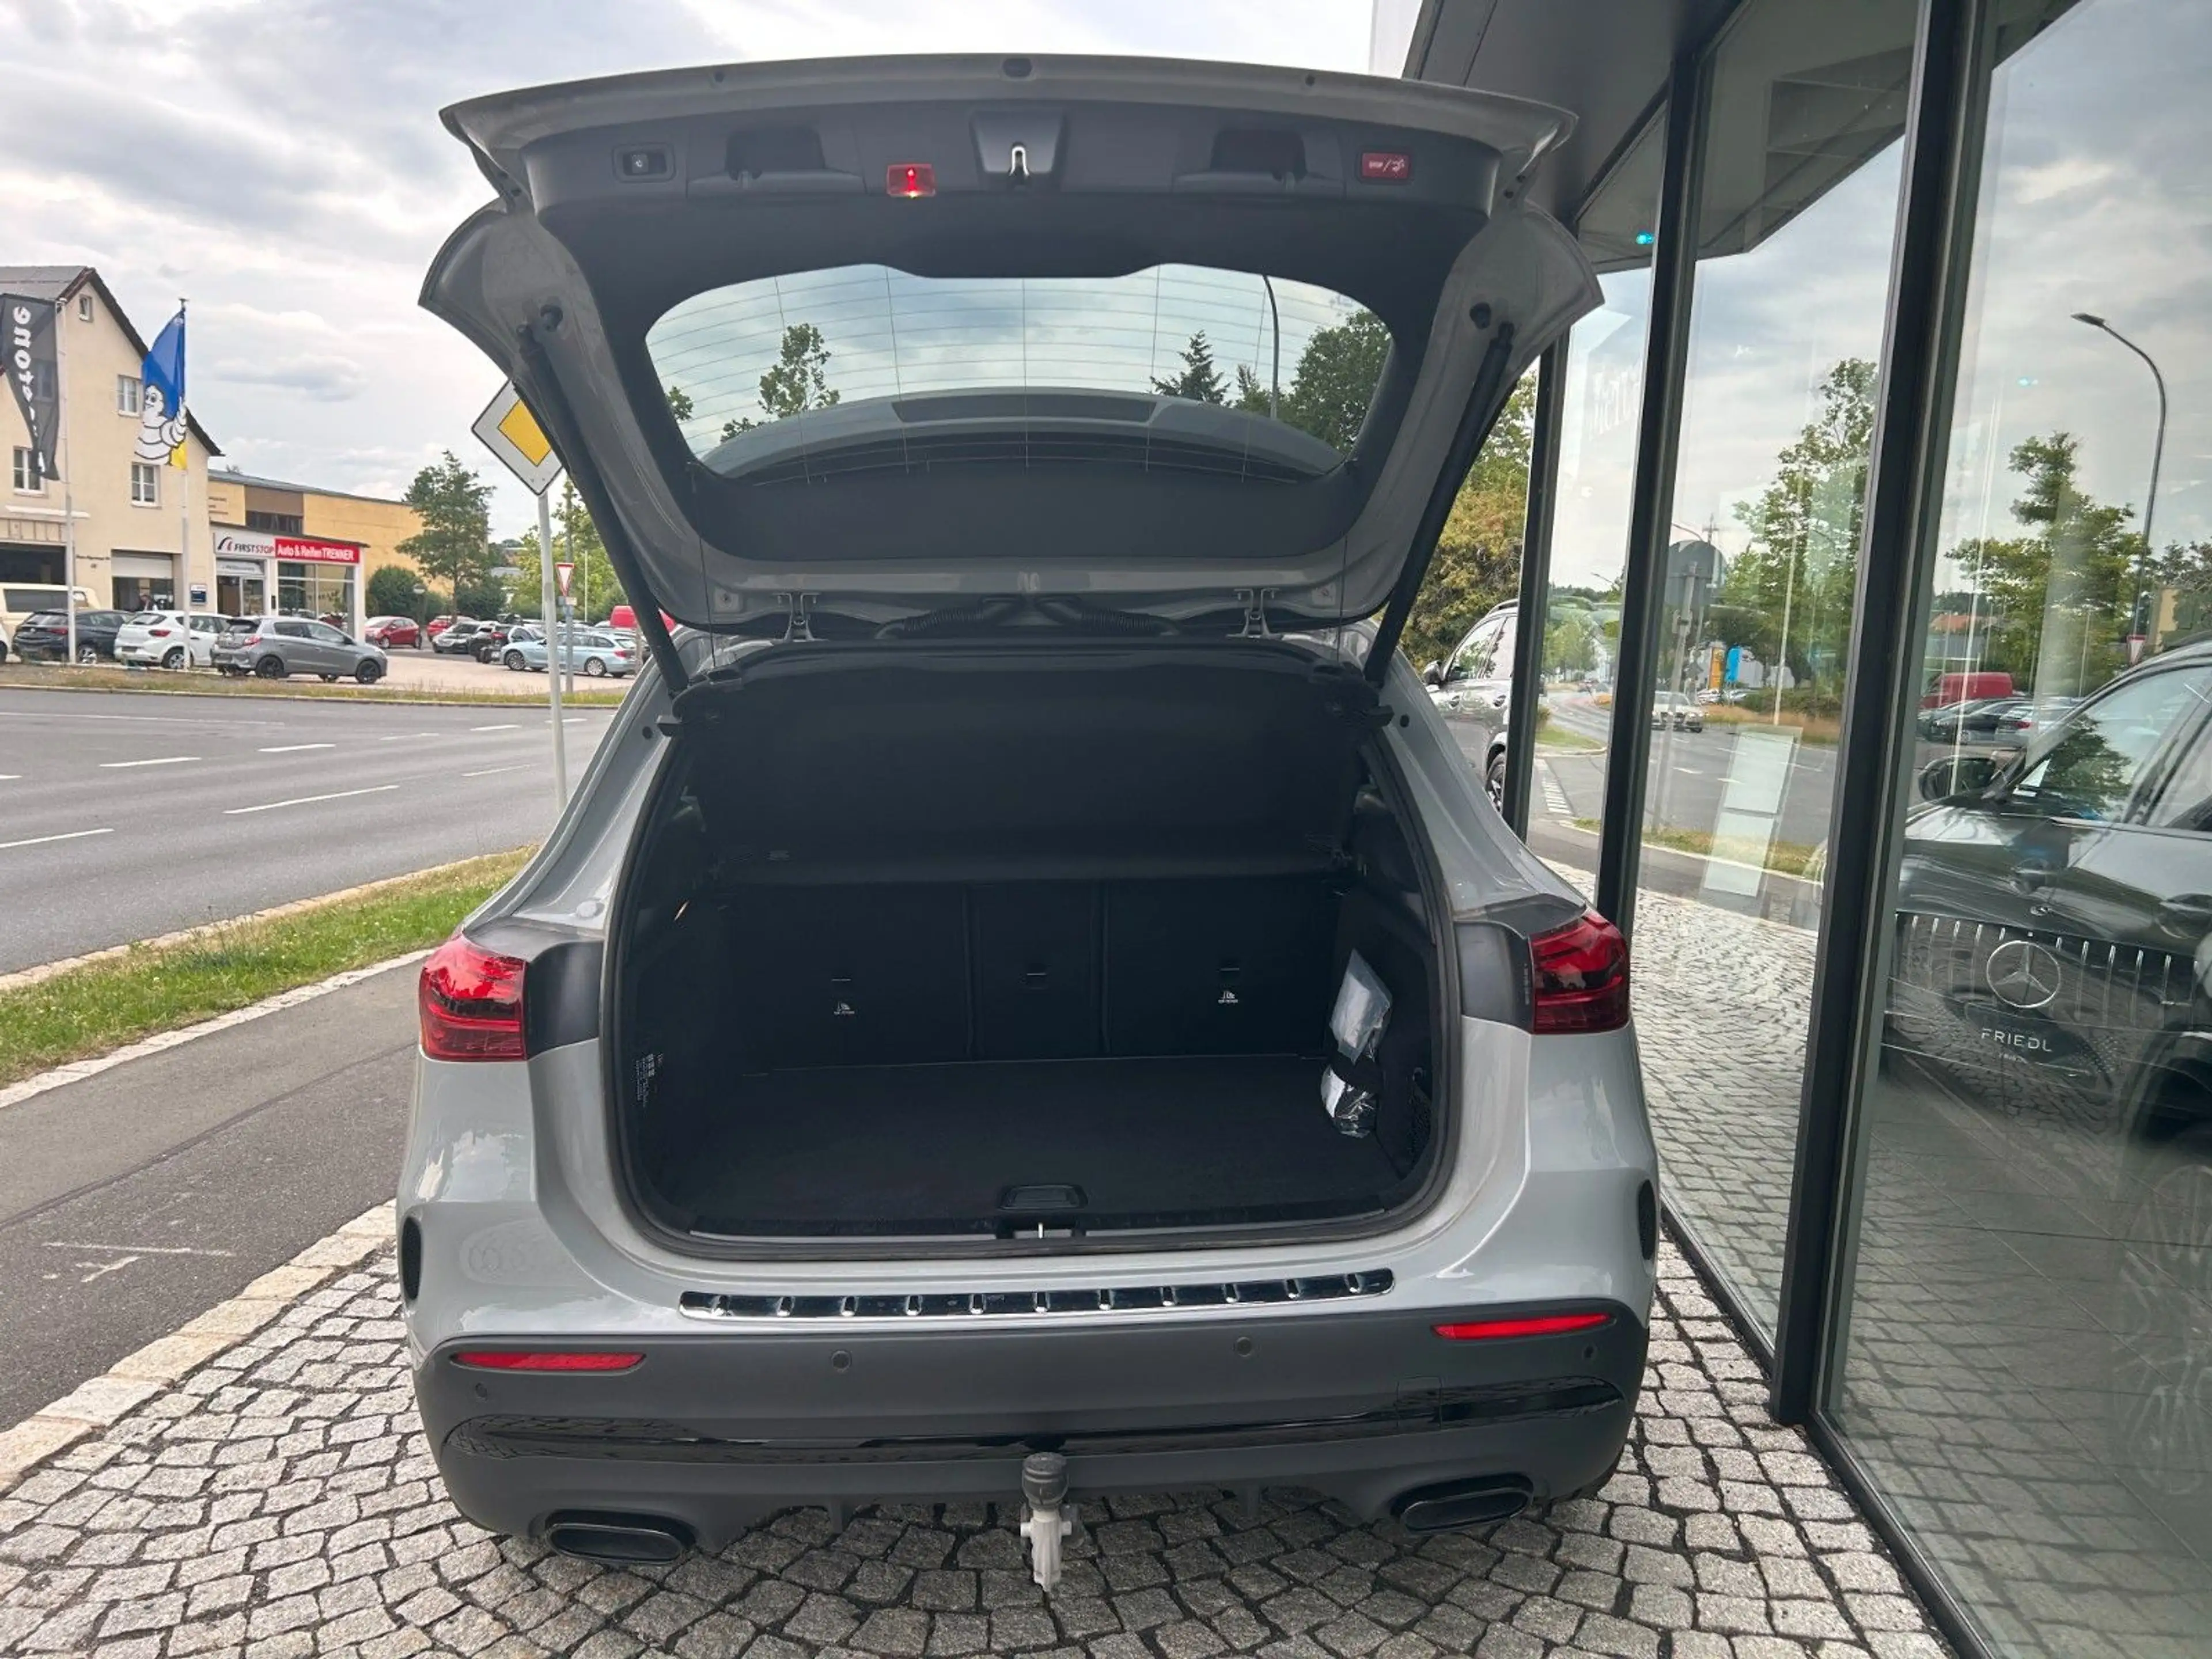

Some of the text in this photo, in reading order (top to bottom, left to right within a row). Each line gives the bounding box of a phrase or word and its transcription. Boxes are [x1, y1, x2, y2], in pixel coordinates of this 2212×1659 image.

[278, 545, 293, 557] Auto
[294, 546, 300, 556] &
[321, 547, 354, 561] TRENNER
[1982, 1027, 2052, 1052] FRIEDL
